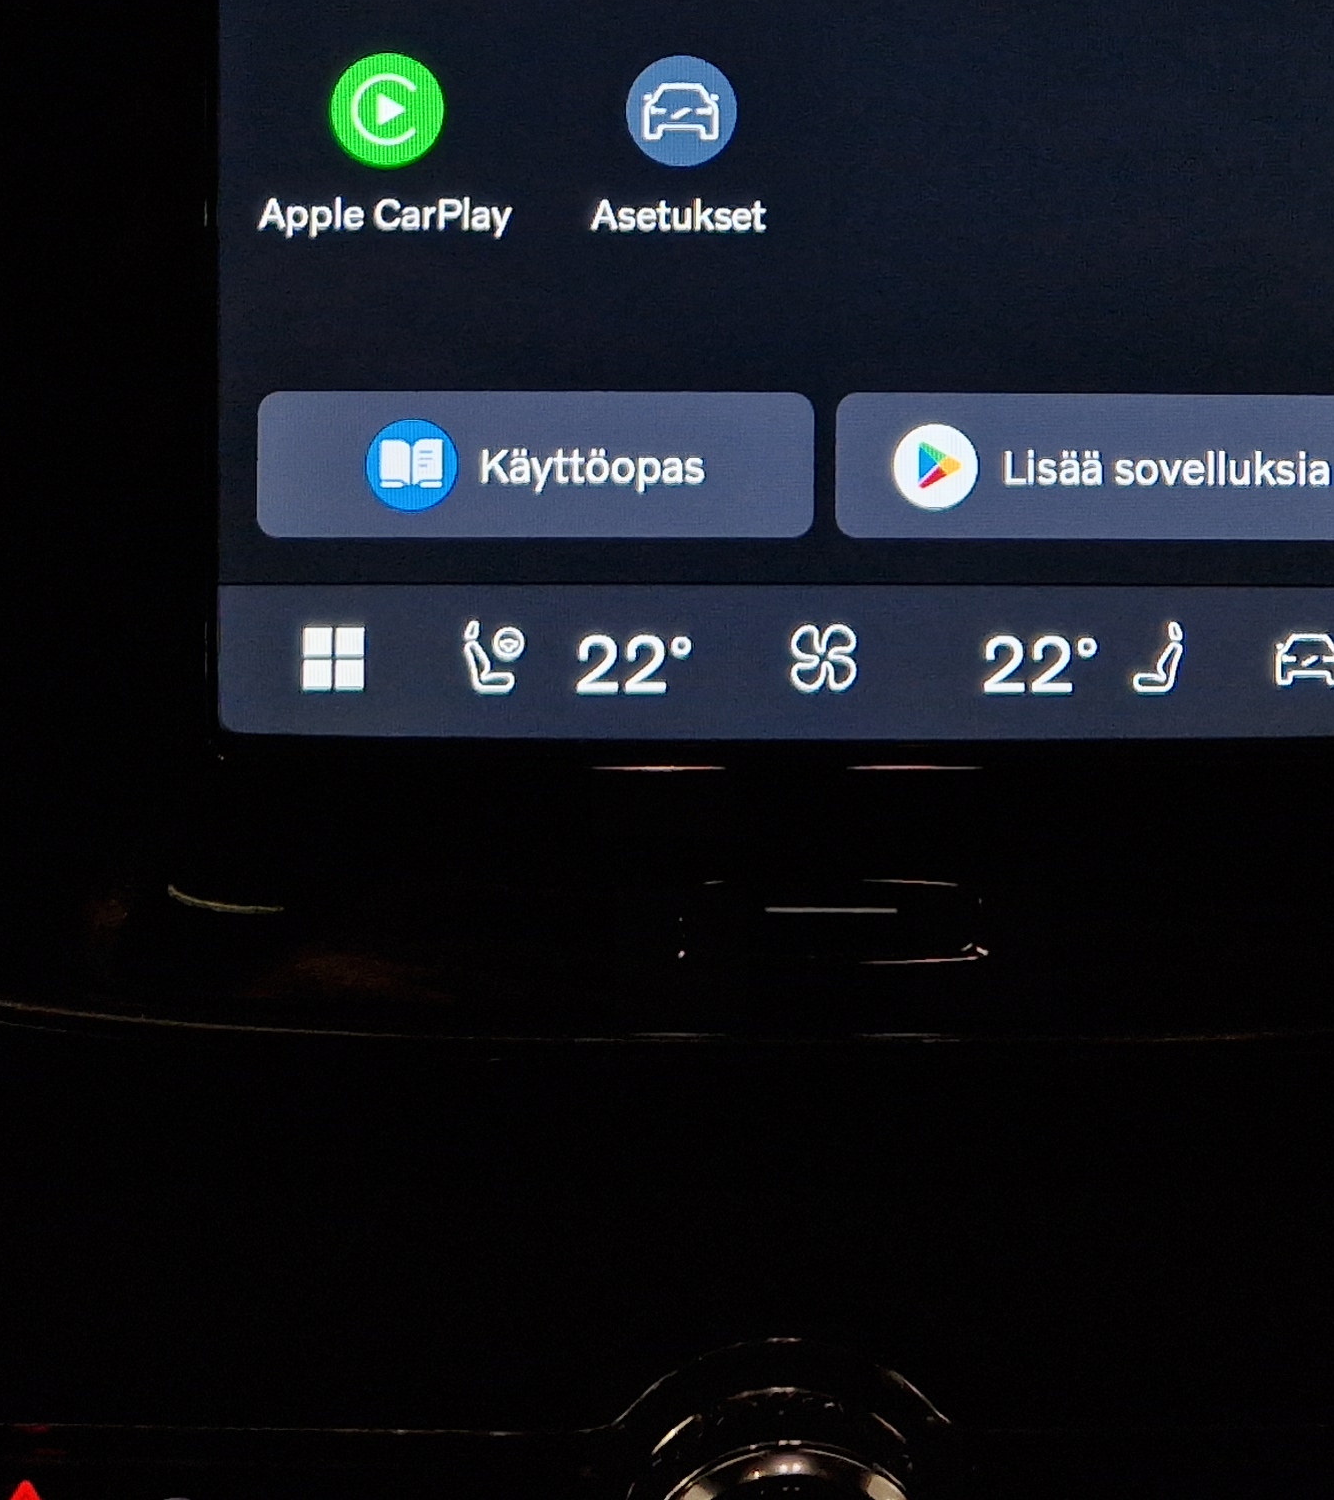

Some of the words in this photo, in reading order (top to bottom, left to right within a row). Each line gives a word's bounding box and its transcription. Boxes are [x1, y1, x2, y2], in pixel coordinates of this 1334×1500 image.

[256, 195, 366, 239] Apple
[372, 195, 514, 240] CarPlay
[589, 196, 768, 234] Asetukset
[480, 446, 706, 495] Käyttöopas
[1003, 448, 1104, 487] Lisää
[1113, 449, 1331, 488] sovelluksia
[575, 633, 693, 695] 22°
[982, 634, 1099, 694] 22°
